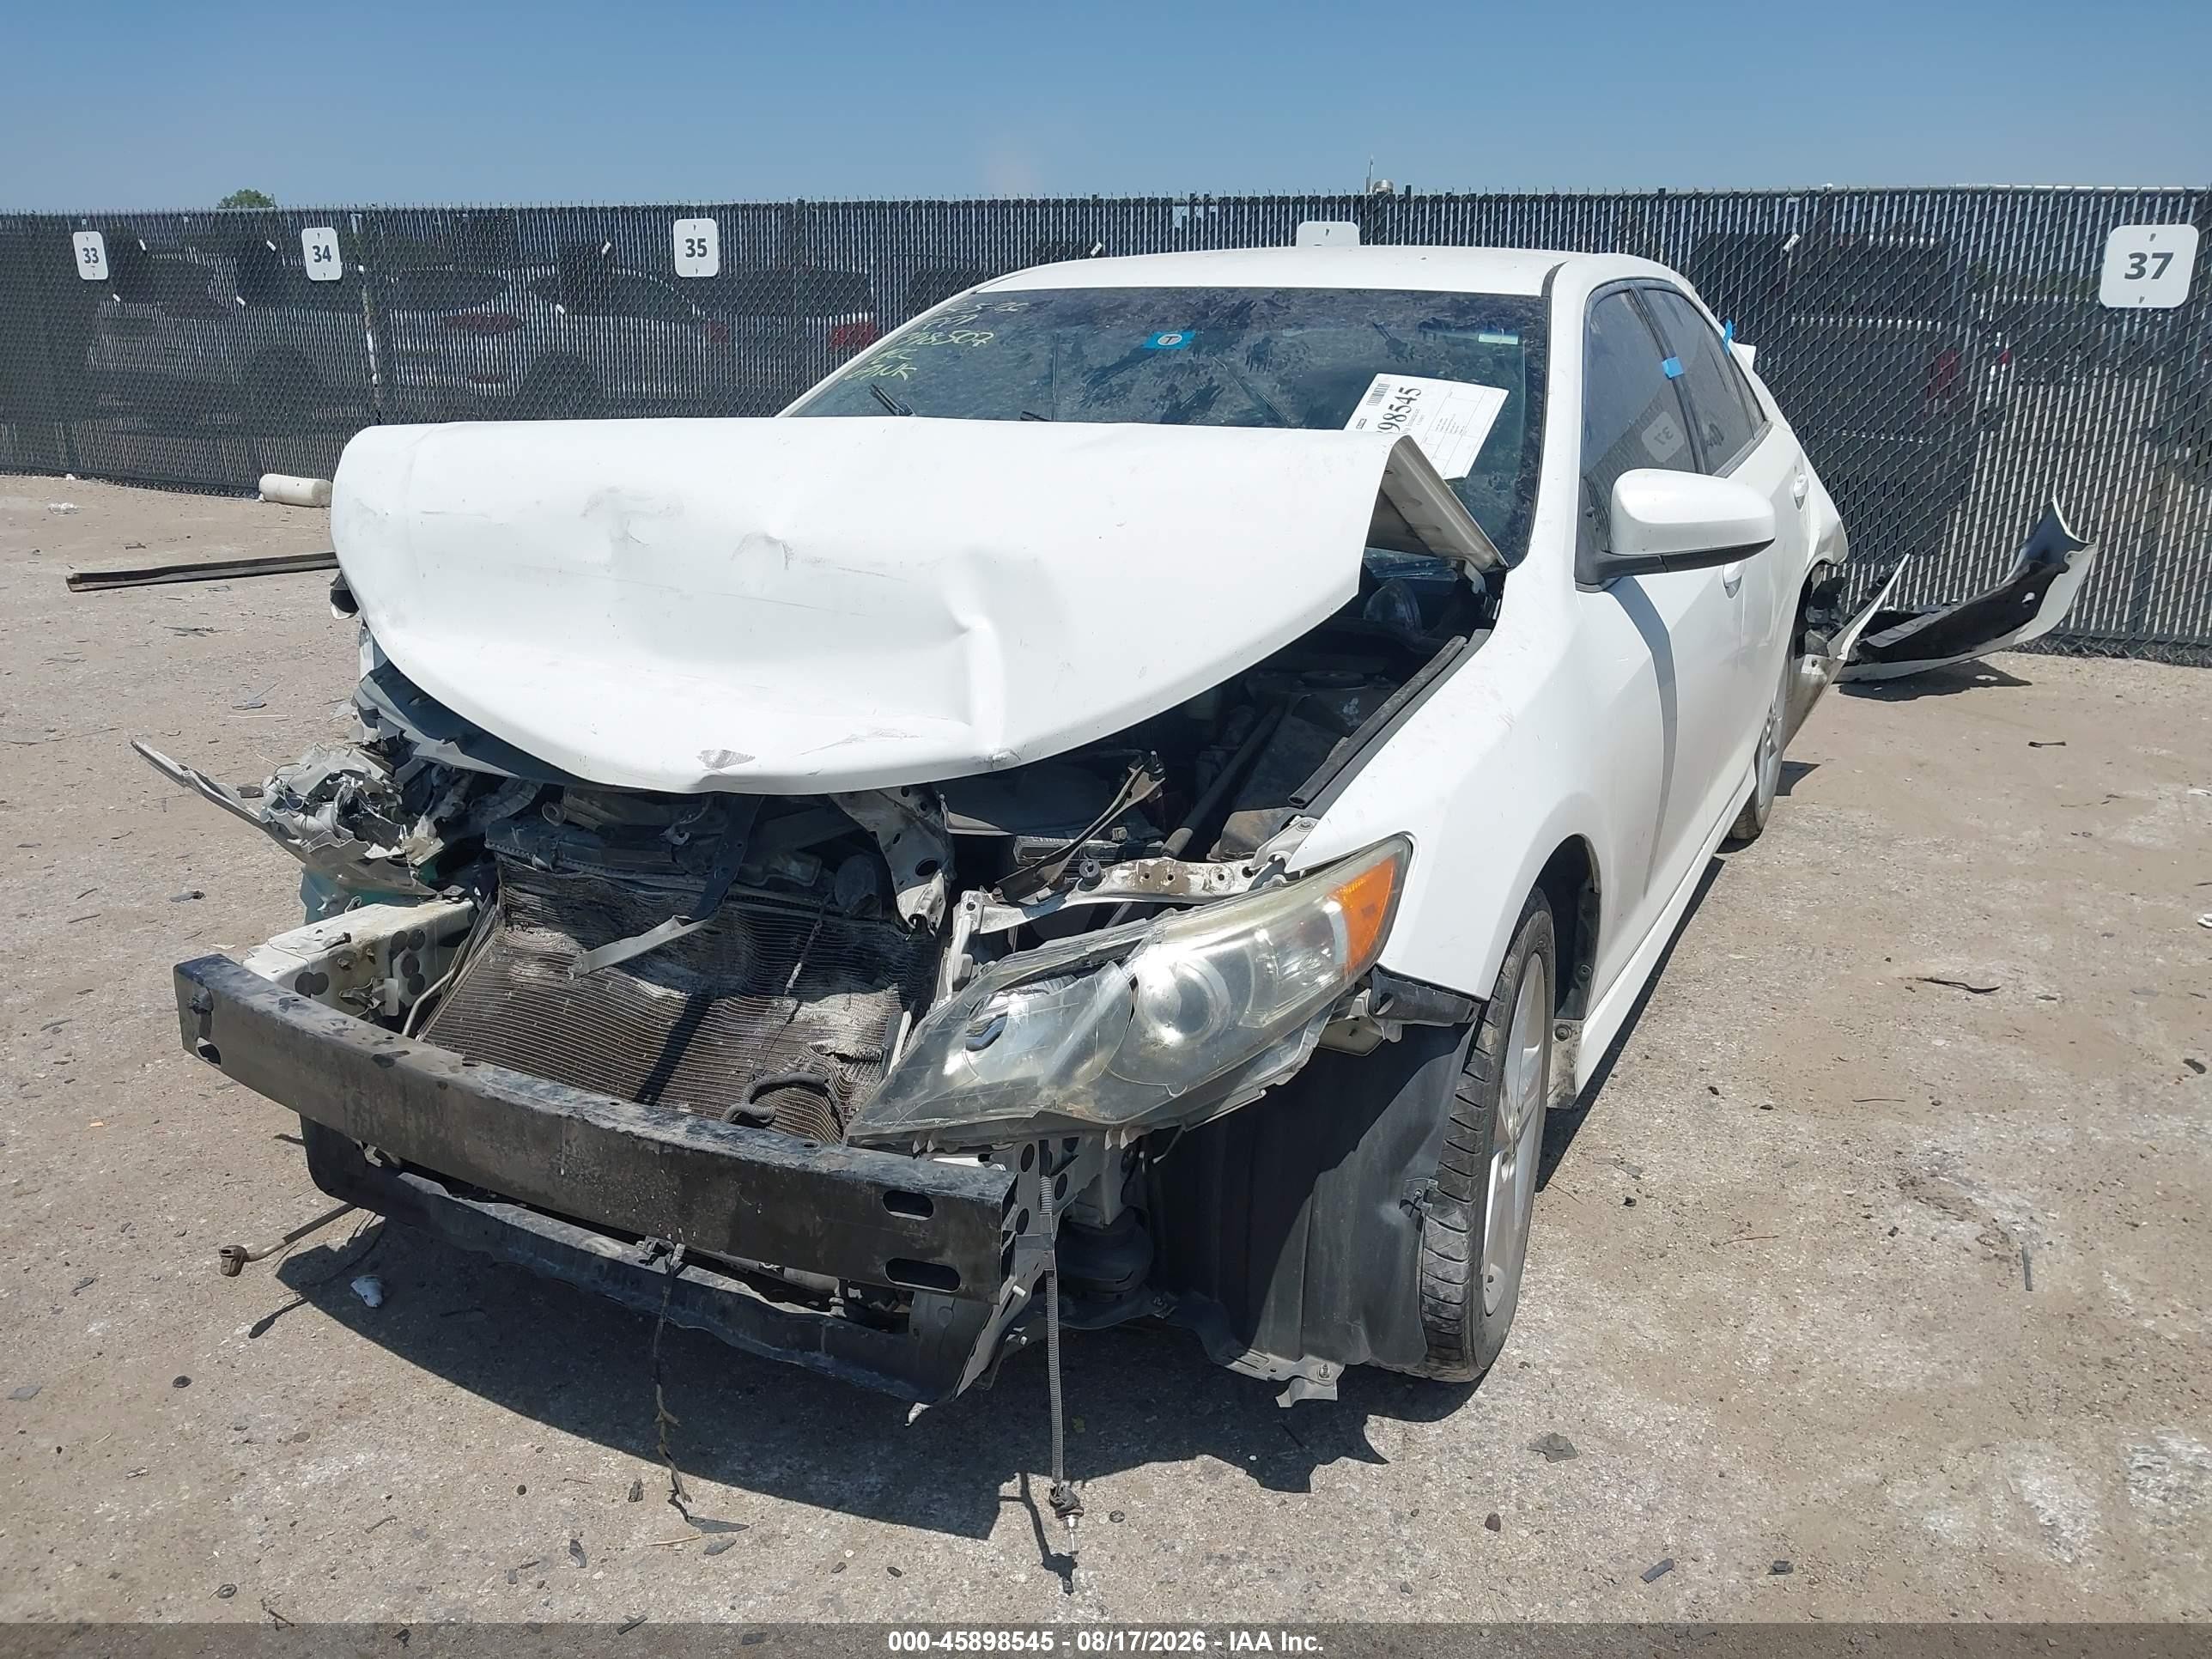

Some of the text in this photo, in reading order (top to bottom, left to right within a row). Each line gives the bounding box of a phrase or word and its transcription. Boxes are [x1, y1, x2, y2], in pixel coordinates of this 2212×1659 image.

[82, 247, 99, 264] 33
[312, 245, 331, 263] 34
[685, 238, 708, 258] 35
[2124, 252, 2174, 280] 37
[1376, 386, 1422, 433] 98545
